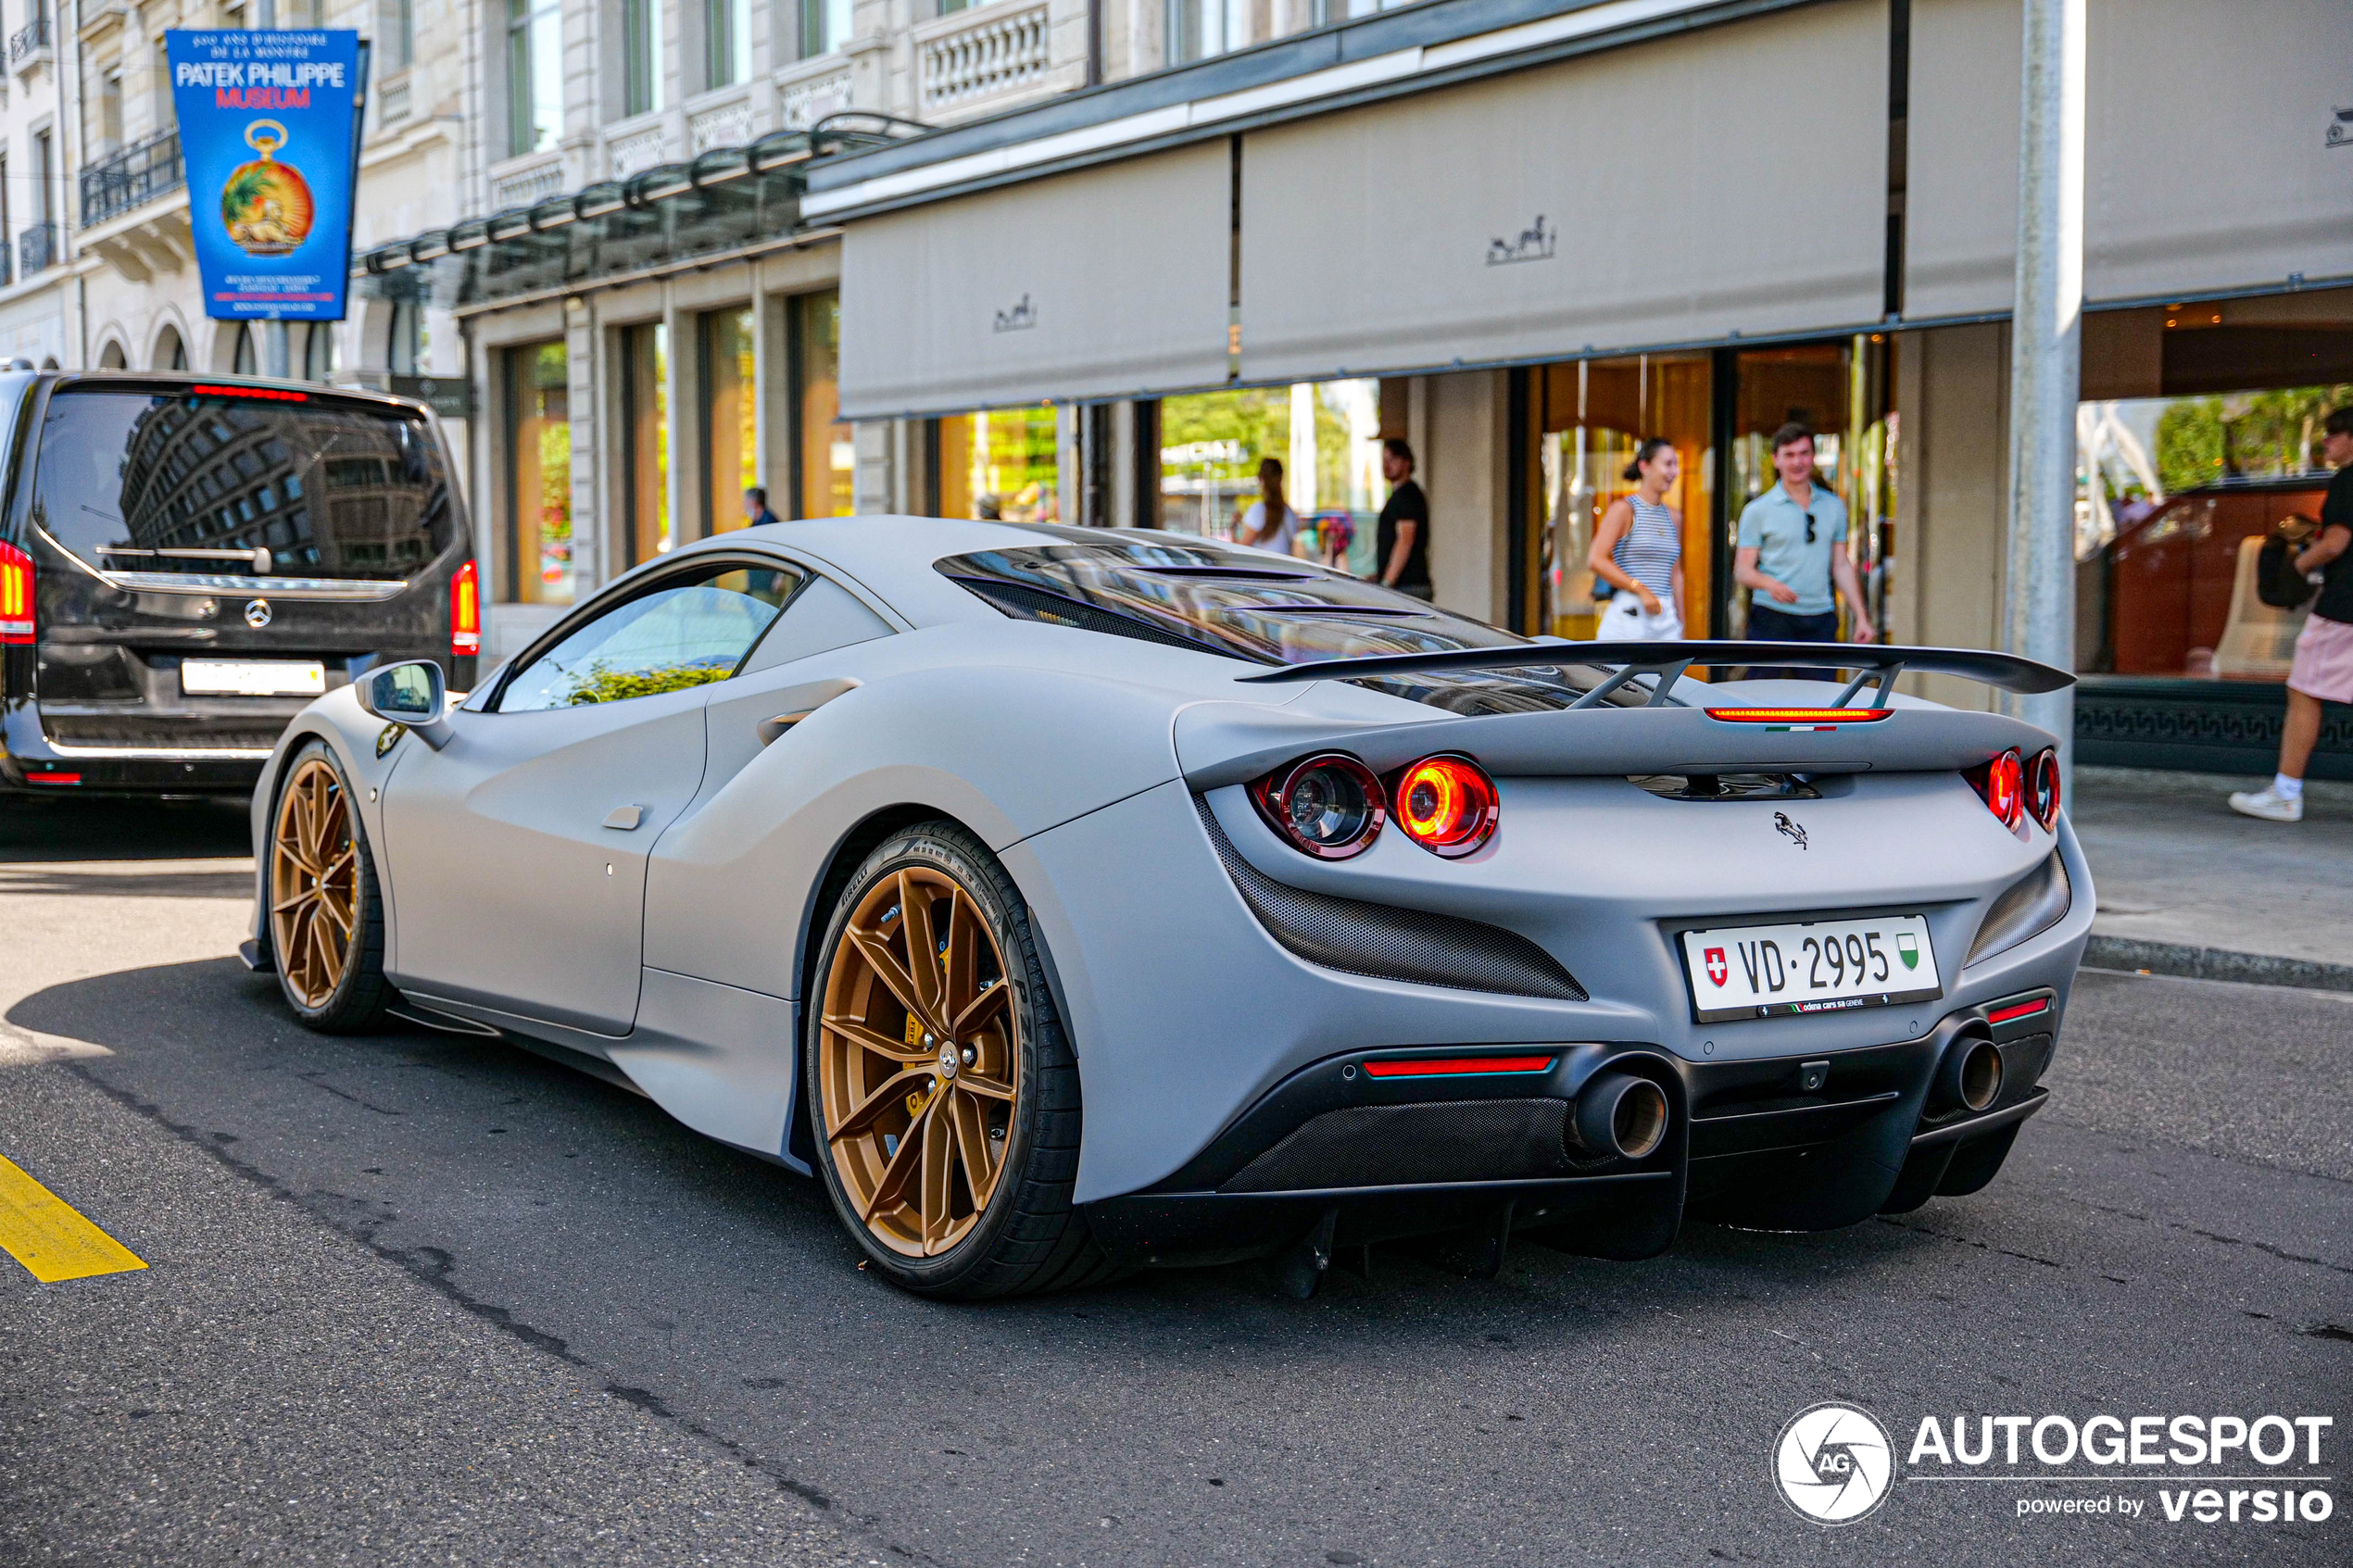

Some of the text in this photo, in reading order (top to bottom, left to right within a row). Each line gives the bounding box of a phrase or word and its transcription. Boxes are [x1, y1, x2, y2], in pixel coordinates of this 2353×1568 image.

[210, 45, 309, 59] DE LA MONTRE
[176, 62, 346, 88] PATEK PHILIPPE
[216, 86, 310, 109] MUSEUM
[1014, 978, 1027, 1004] P
[1822, 999, 1837, 1010] cars
[1837, 999, 1846, 1009] sa
